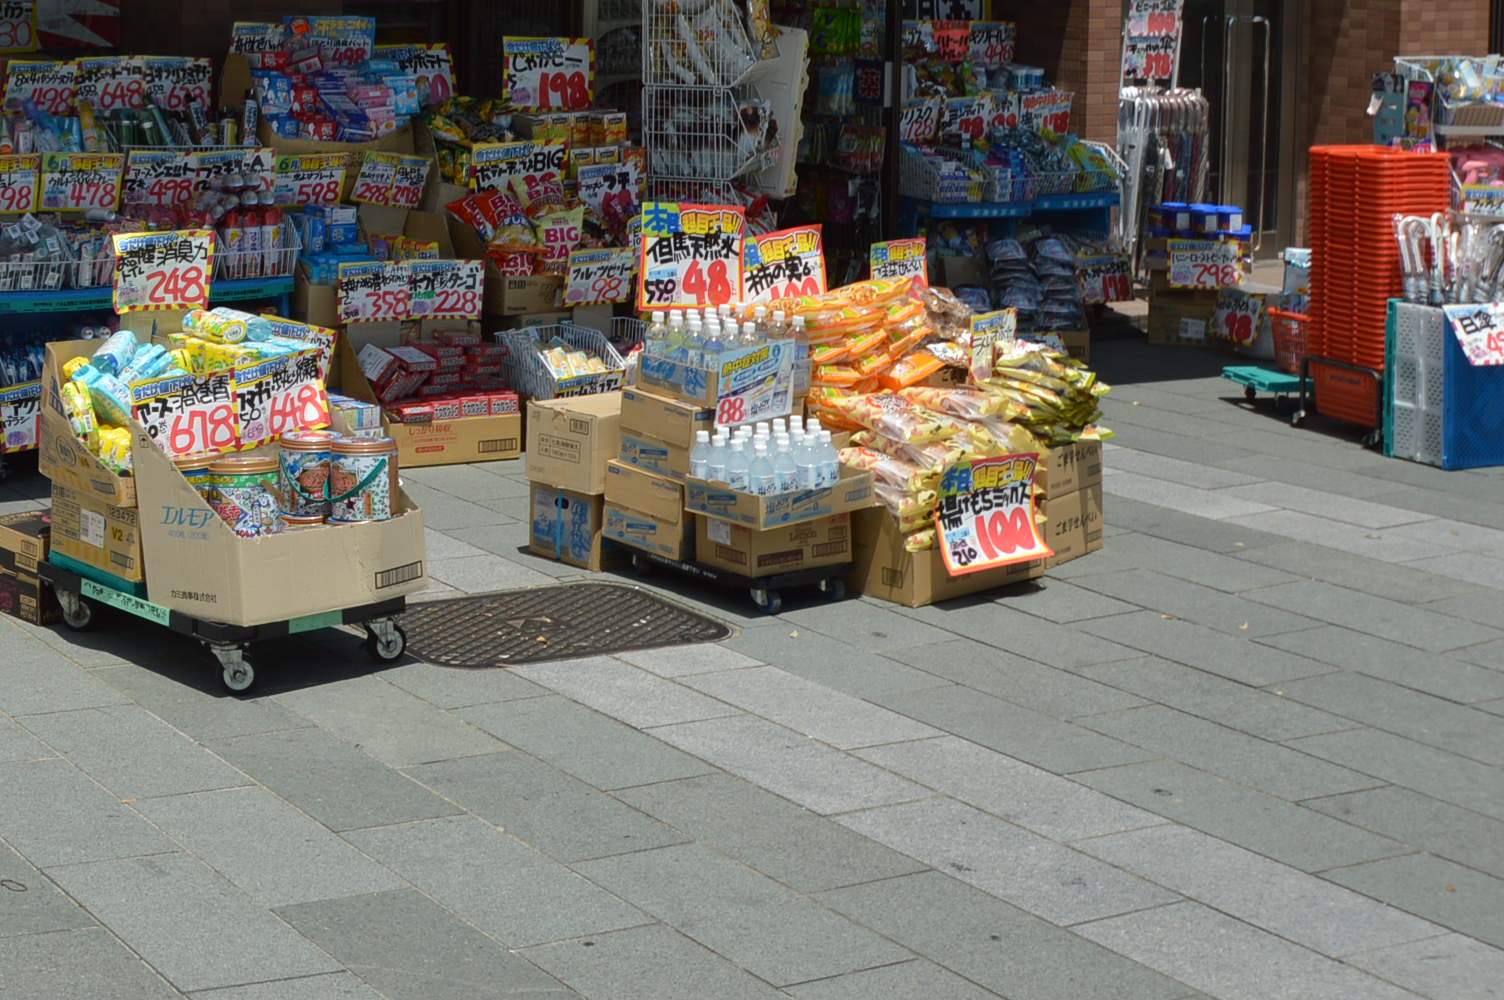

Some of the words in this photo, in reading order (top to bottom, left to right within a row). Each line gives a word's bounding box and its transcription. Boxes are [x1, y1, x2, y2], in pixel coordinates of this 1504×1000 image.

[100, 80, 144, 110] 648
[538, 70, 593, 111] 198
[70, 183, 117, 208] 478
[149, 179, 193, 205] 498
[296, 180, 340, 204] 598
[544, 226, 580, 244] BIG
[146, 266, 205, 303] 248
[592, 278, 623, 301] 98
[681, 259, 733, 307] 48
[434, 289, 479, 314] 228
[268, 384, 326, 436] 648
[717, 396, 747, 425] 88
[169, 403, 237, 454] 678
[975, 505, 1037, 562] 100
